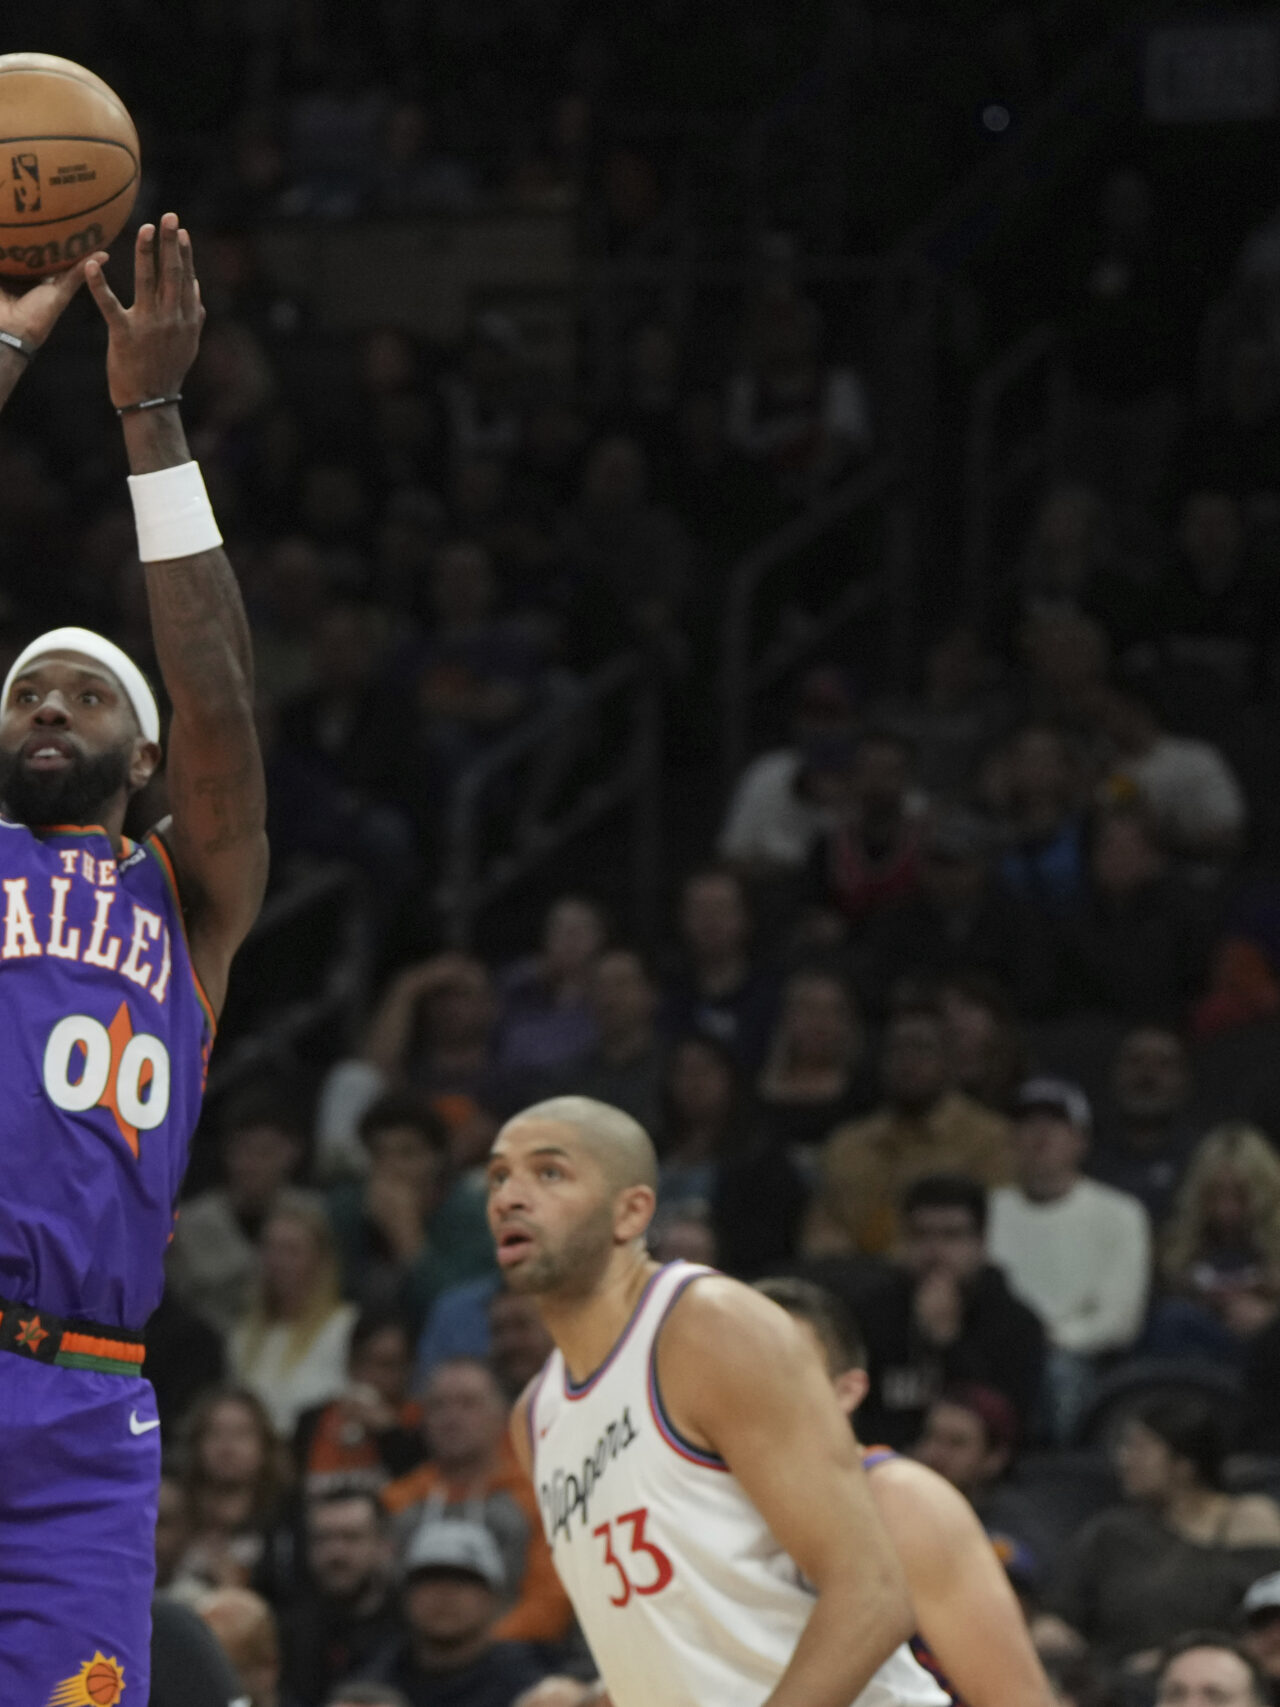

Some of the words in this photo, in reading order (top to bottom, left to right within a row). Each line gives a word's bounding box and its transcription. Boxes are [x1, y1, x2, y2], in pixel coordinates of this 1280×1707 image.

[60, 849, 117, 886] THE
[43, 1014, 170, 1130] 00
[593, 1507, 674, 1607] 33
